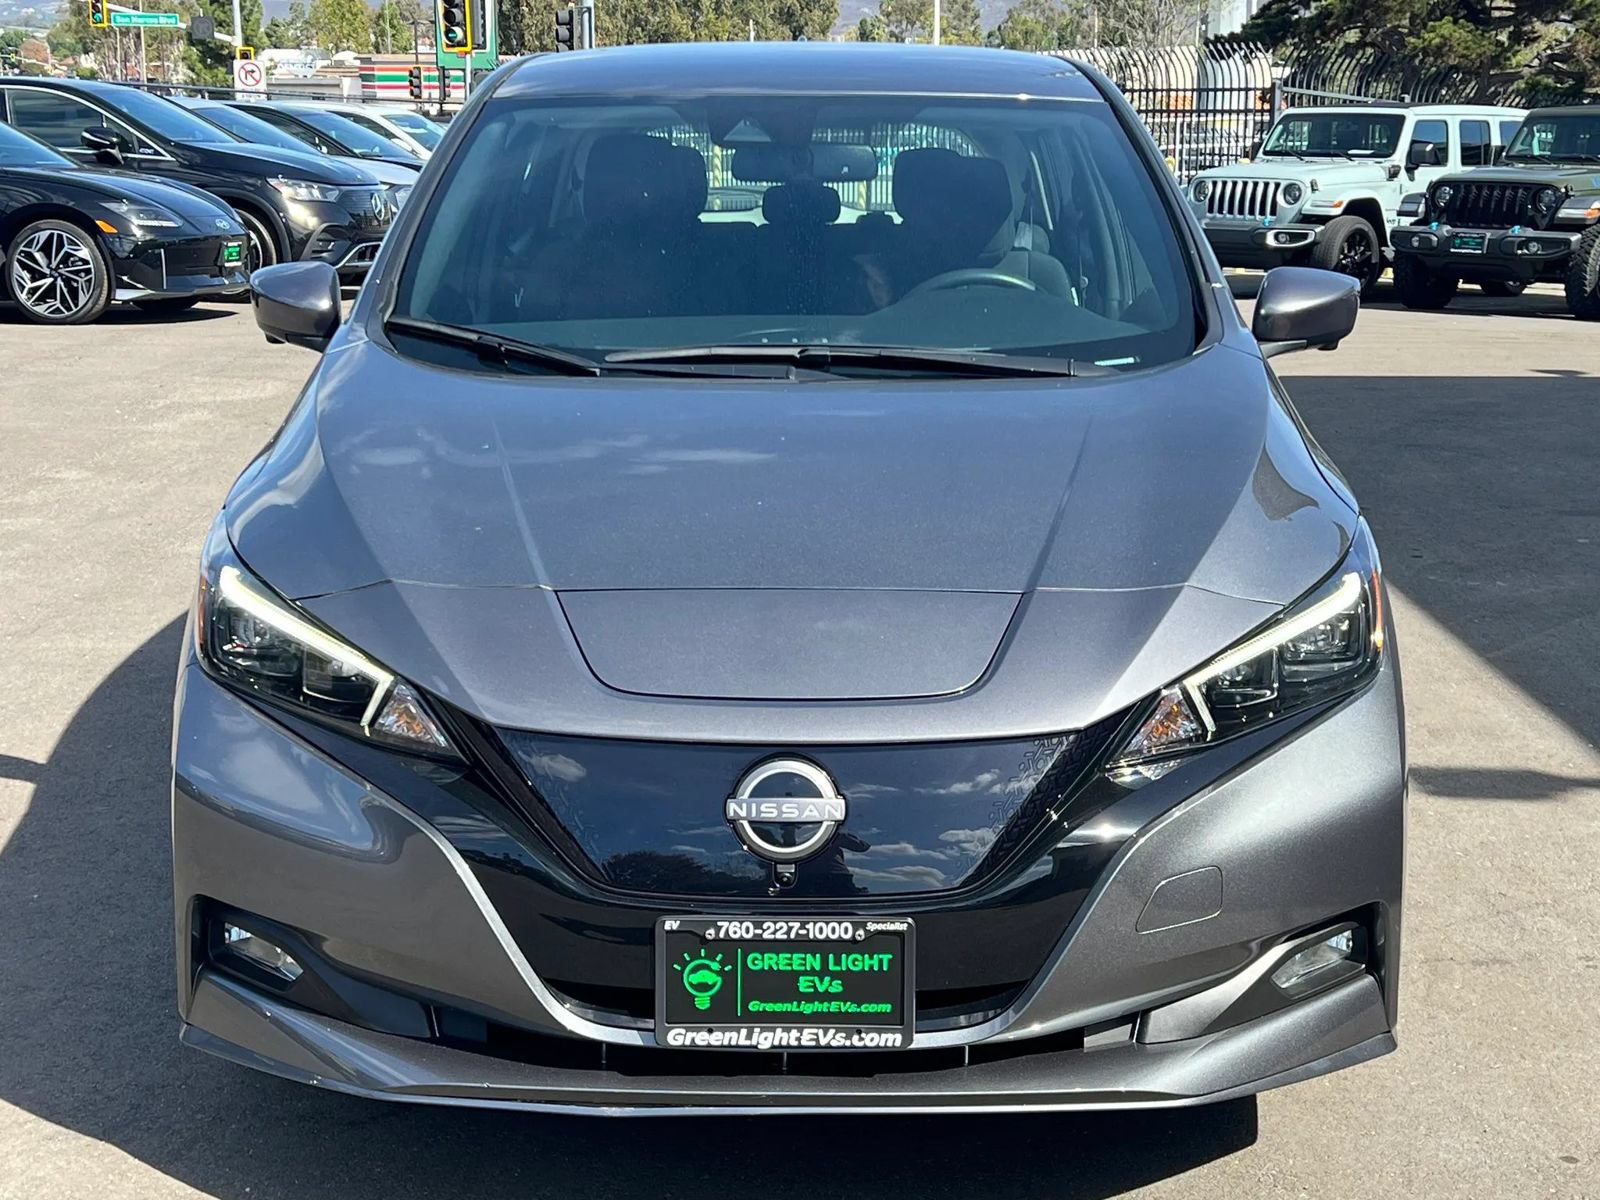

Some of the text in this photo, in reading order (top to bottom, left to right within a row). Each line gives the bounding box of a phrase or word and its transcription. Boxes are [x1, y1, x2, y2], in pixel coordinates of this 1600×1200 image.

[729, 801, 842, 818] NISSAN
[664, 920, 680, 931] EV
[717, 921, 853, 939] 760-227-1000
[865, 921, 908, 931] Specialist
[747, 953, 893, 971] GREEN LIGHT
[797, 976, 843, 993] EVs
[748, 1000, 892, 1014] GreenLightEVs.com
[667, 1028, 902, 1049] GreenLightEVs.com
